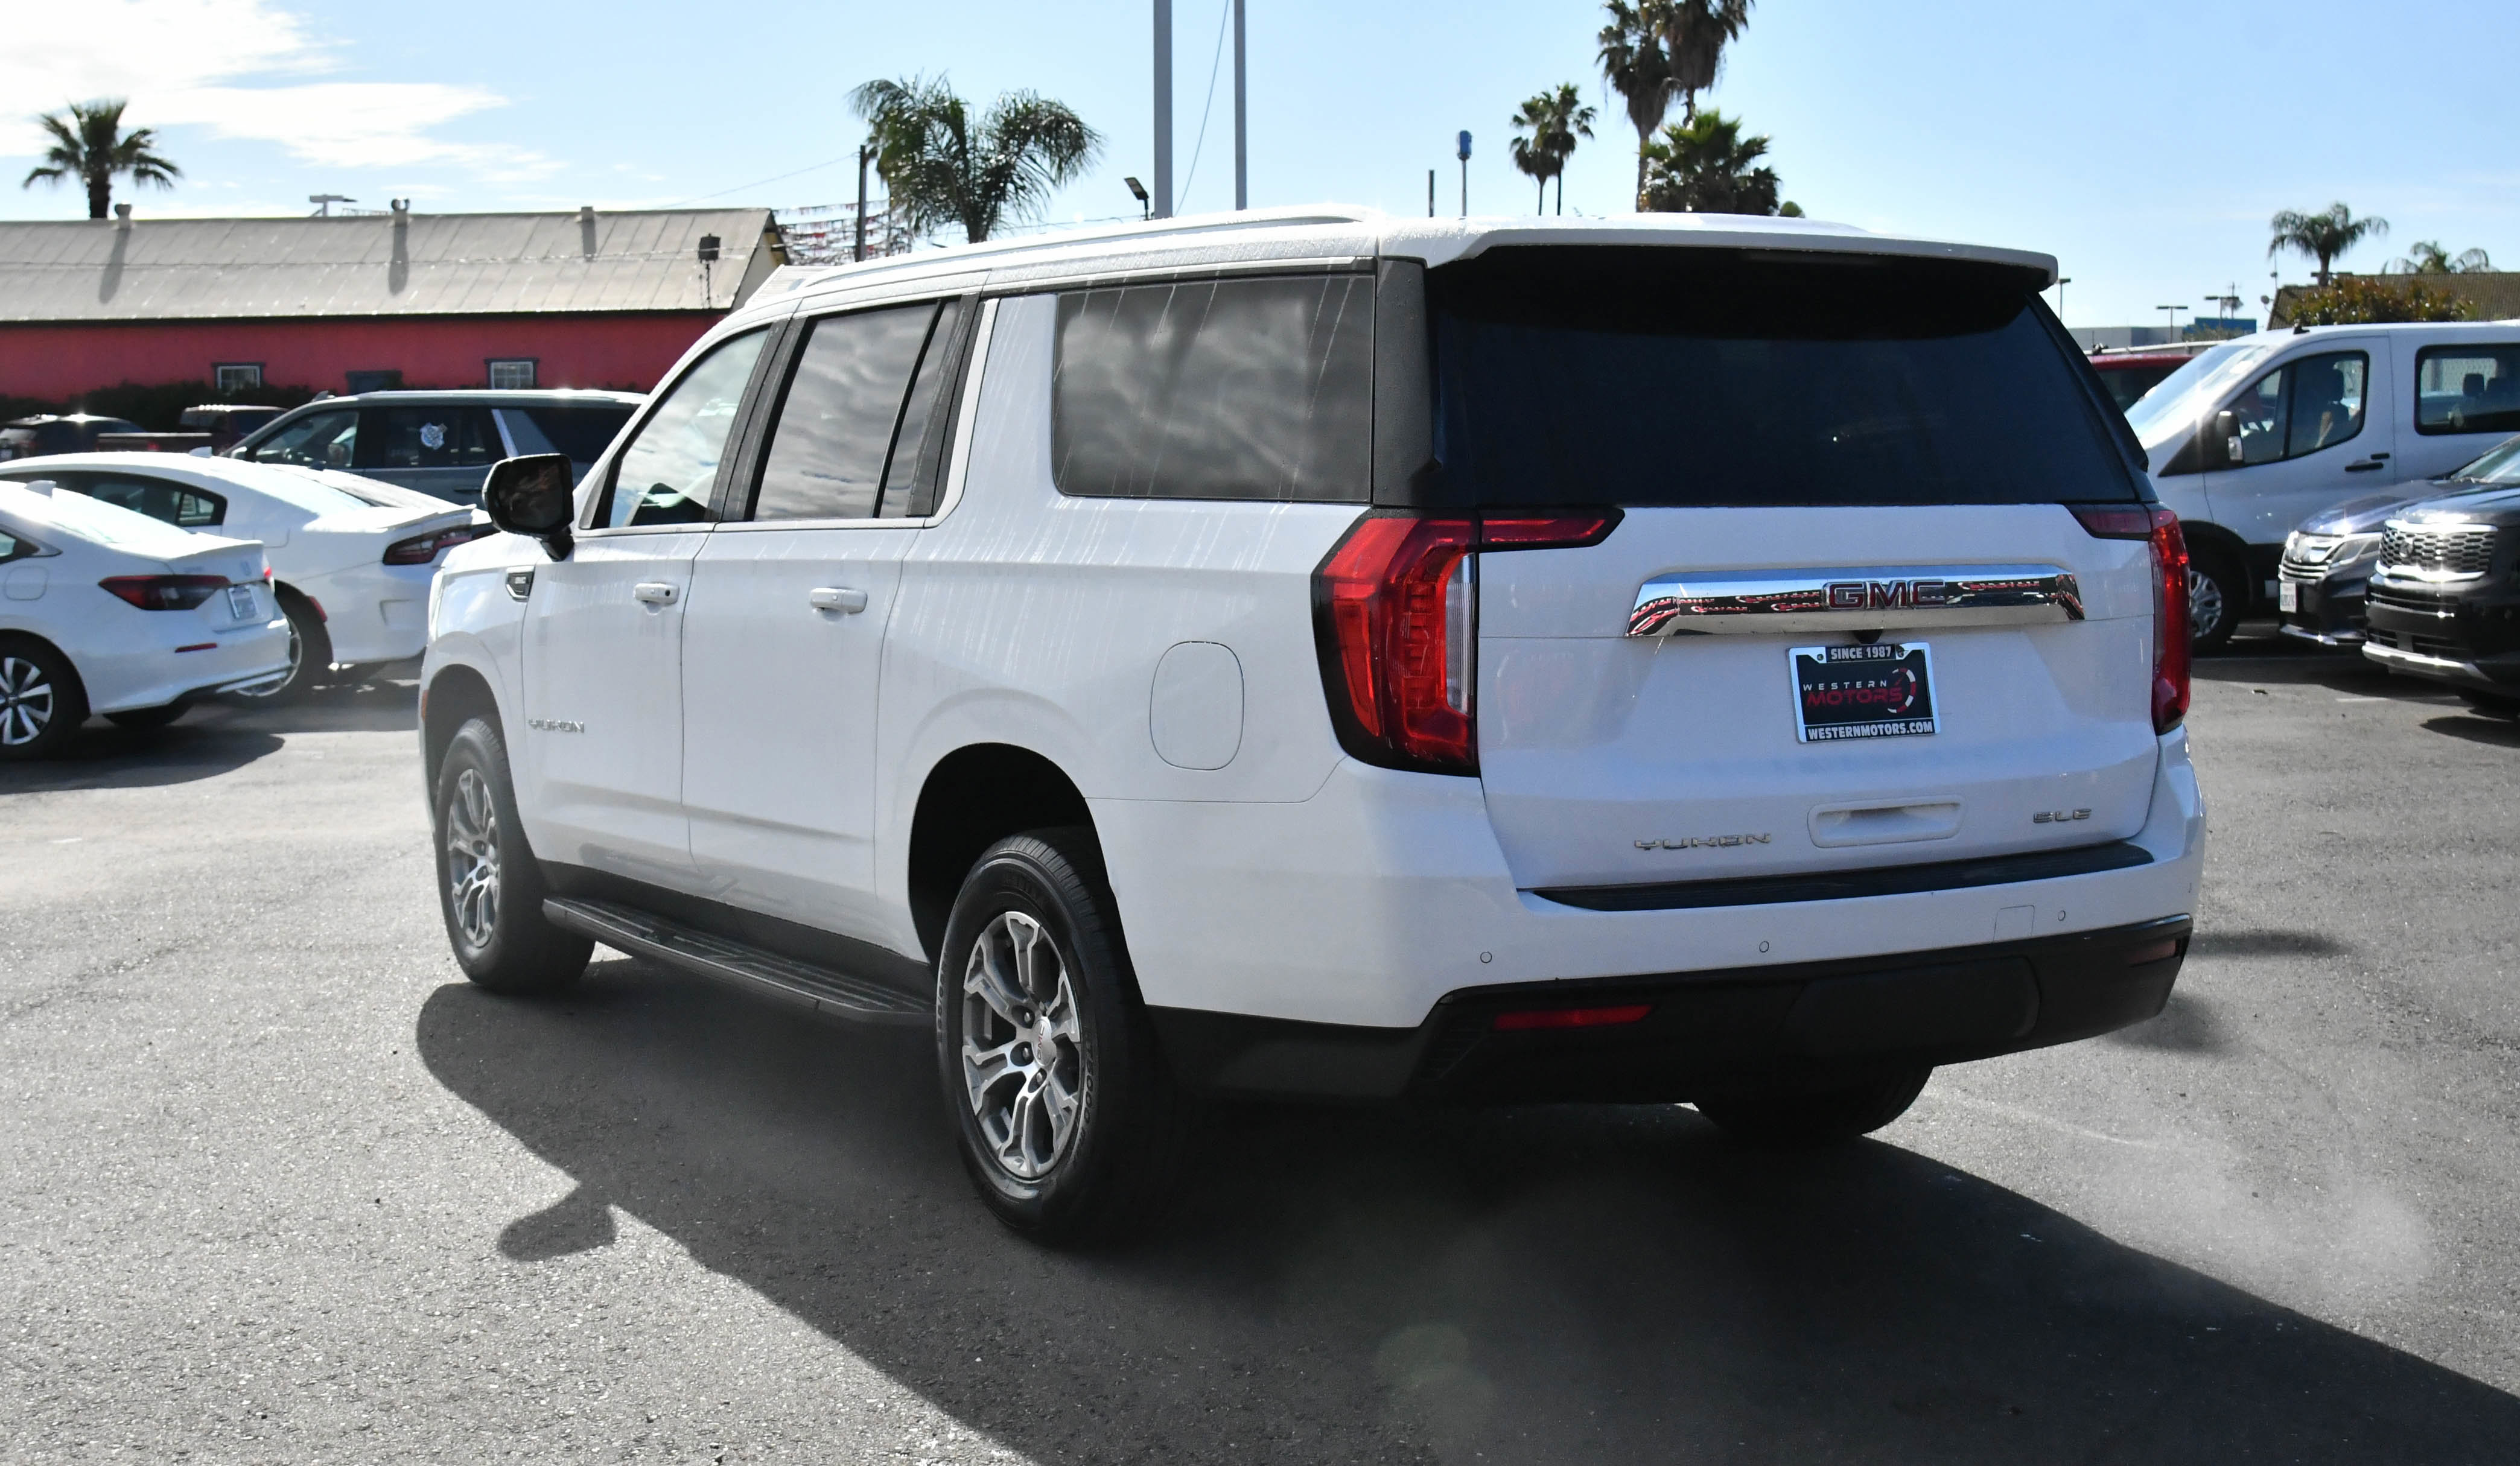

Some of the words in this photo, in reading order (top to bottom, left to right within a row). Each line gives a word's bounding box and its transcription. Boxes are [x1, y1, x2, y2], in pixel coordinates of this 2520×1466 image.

[1824, 580, 1946, 610] GMC
[1831, 648, 1862, 659] SINCE
[1866, 646, 1891, 658] 1987
[1802, 680, 1887, 691] WESTERN
[1807, 687, 1902, 706] MOTORS
[528, 719, 584, 734] YUKON
[1809, 722, 1933, 740] WESTERNMOTORS.COM
[1635, 833, 1772, 851] YUKON
